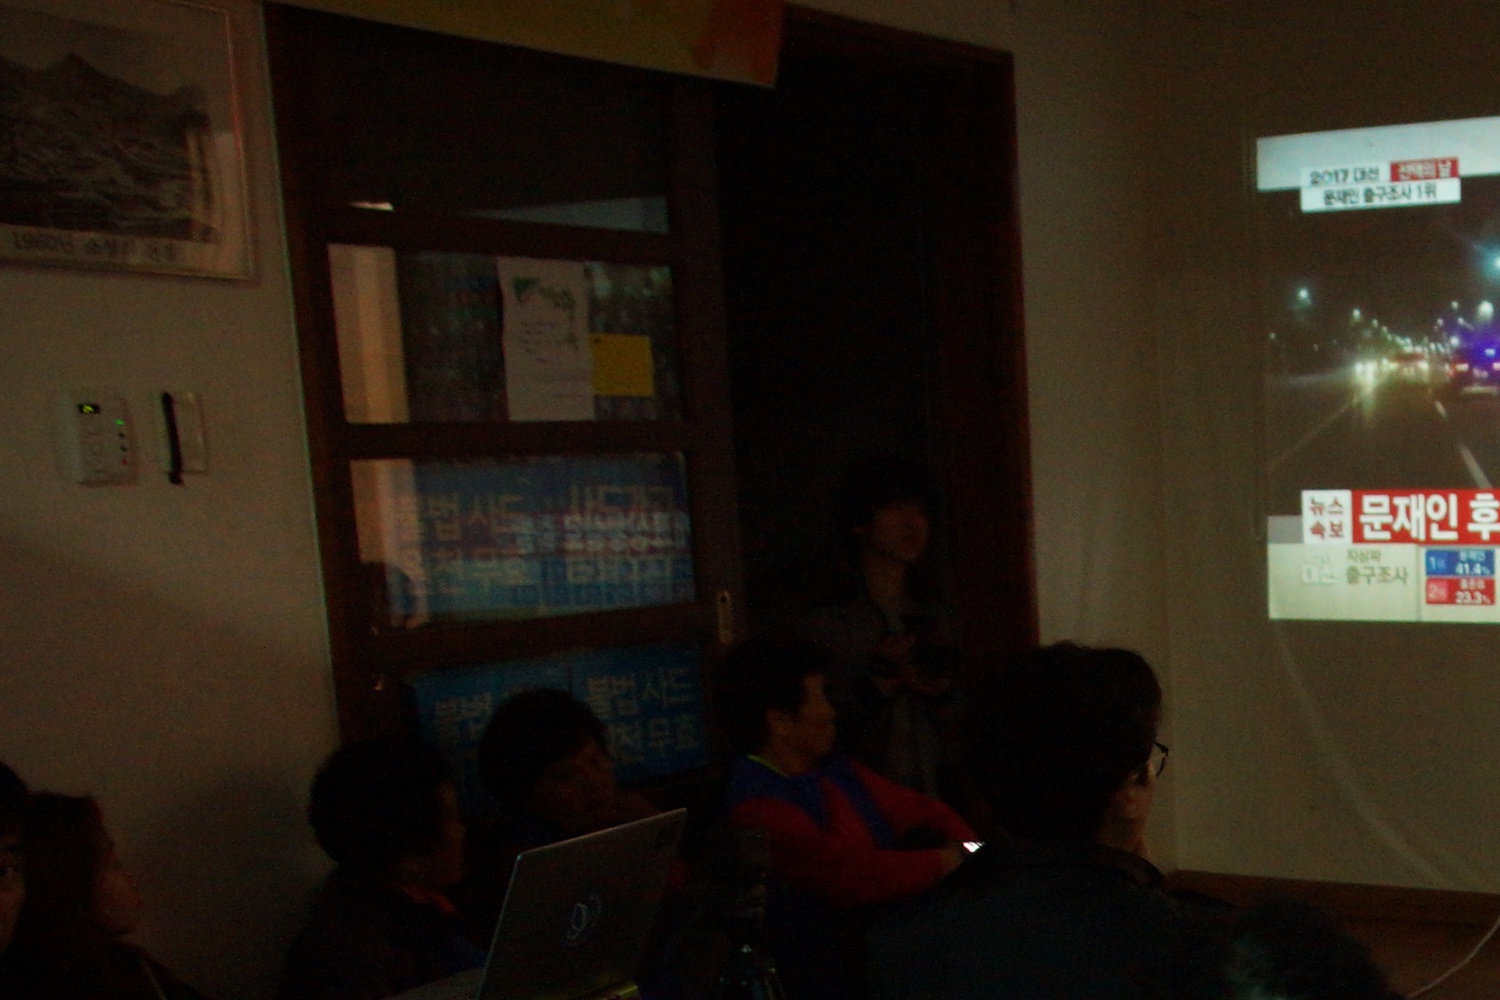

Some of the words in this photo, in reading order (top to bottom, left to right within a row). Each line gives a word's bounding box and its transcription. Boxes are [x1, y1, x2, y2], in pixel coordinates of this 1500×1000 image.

[1363, 184, 1412, 203] 출구조사
[1309, 497, 1344, 518] 뉴스
[1359, 493, 1459, 542] 문재인
[1309, 521, 1344, 539] 속보
[1347, 566, 1408, 585] 출구조사
